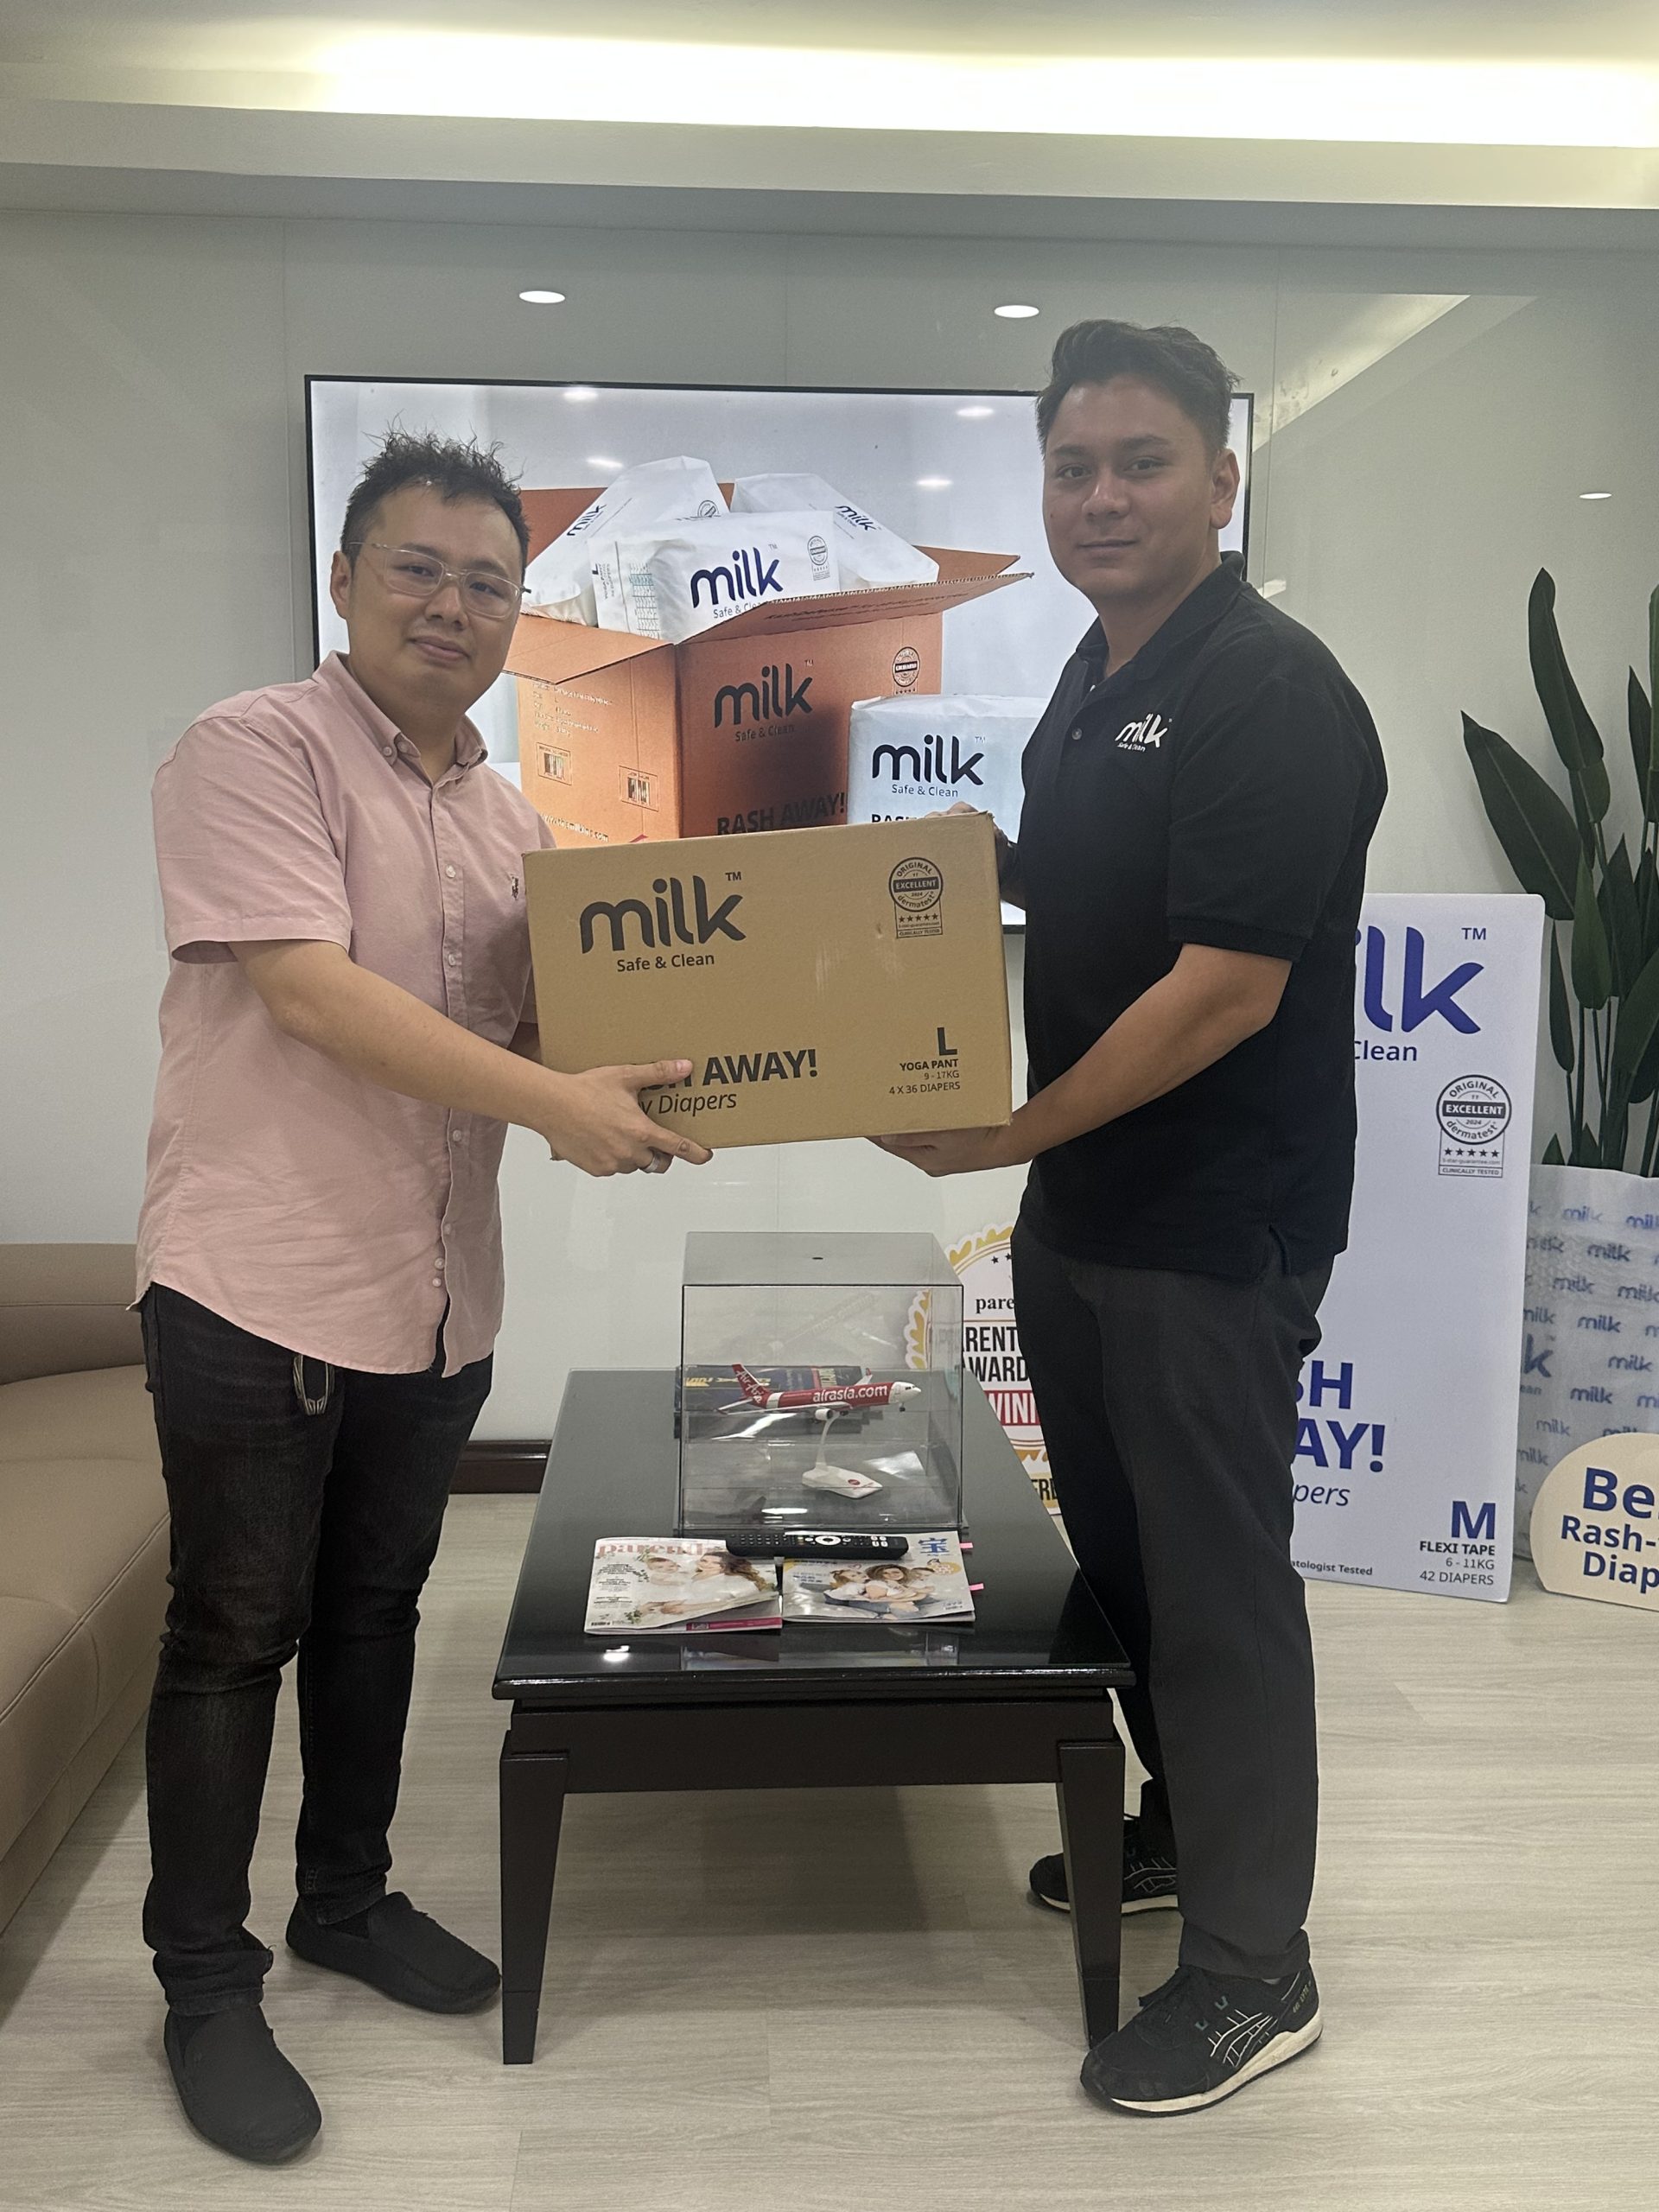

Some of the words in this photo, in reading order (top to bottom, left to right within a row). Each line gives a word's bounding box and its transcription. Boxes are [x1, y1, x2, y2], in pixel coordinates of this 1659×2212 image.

[690, 547, 784, 608] milk
[713, 607, 733, 619] Safe
[734, 605, 741, 614] &
[715, 663, 813, 728] milk
[734, 728, 756, 741] Safe
[872, 734, 985, 785] milk
[892, 784, 914, 795] Safe
[918, 785, 925, 795] &
[929, 786, 958, 798] Clean
[717, 808, 774, 836] RASH
[780, 792, 845, 828] AWAY!
[725, 871, 742, 881] TM
[897, 861, 933, 877] ORIGINAL
[895, 879, 937, 889] EXCELLENT
[897, 893, 935, 908] dermatest
[580, 875, 747, 954] milk
[1462, 927, 1487, 940] TM
[617, 957, 651, 972] Safe
[655, 956, 666, 969] &
[671, 954, 715, 968] Clean
[937, 1027, 958, 1056] L
[702, 1049, 817, 1086] AWAY!
[899, 1061, 929, 1071] YOGA
[931, 1058, 958, 1069] PANT
[937, 1070, 959, 1079] 17KG
[889, 1086, 895, 1095] 4
[897, 1085, 904, 1094] X
[906, 1084, 918, 1093] 36
[920, 1081, 961, 1092] DIAPERS
[1449, 1081, 1499, 1099] ORIGINAL
[658, 1093, 737, 1116] Diapers
[1446, 1104, 1503, 1115] EXCELLENT
[1446, 1121, 1497, 1140] dermatest
[1587, 1242, 1631, 1262] milk
[976, 1298, 1015, 1314] pare
[1577, 1315, 1622, 1333] milk
[1608, 1354, 1654, 1372] milk
[813, 1385, 888, 1402] airasia.com
[1570, 1386, 1614, 1405] milk
[1535, 1419, 1571, 1437] milk
[1295, 1417, 1385, 1472] AY!
[1294, 1484, 1351, 1506] pers
[1583, 1467, 1659, 1519] Be
[1452, 1501, 1496, 1540] M
[1561, 1515, 1659, 1553] Rash-
[1420, 1541, 1458, 1554] FLEXI
[1462, 1543, 1496, 1556] TAPE
[1292, 1560, 1336, 1572] tologist
[1338, 1564, 1373, 1576] Tested
[1446, 1557, 1452, 1567] 6
[1464, 1559, 1495, 1570] 11KG
[1420, 1571, 1435, 1582] 42
[1439, 1572, 1494, 1586] DIAPERS
